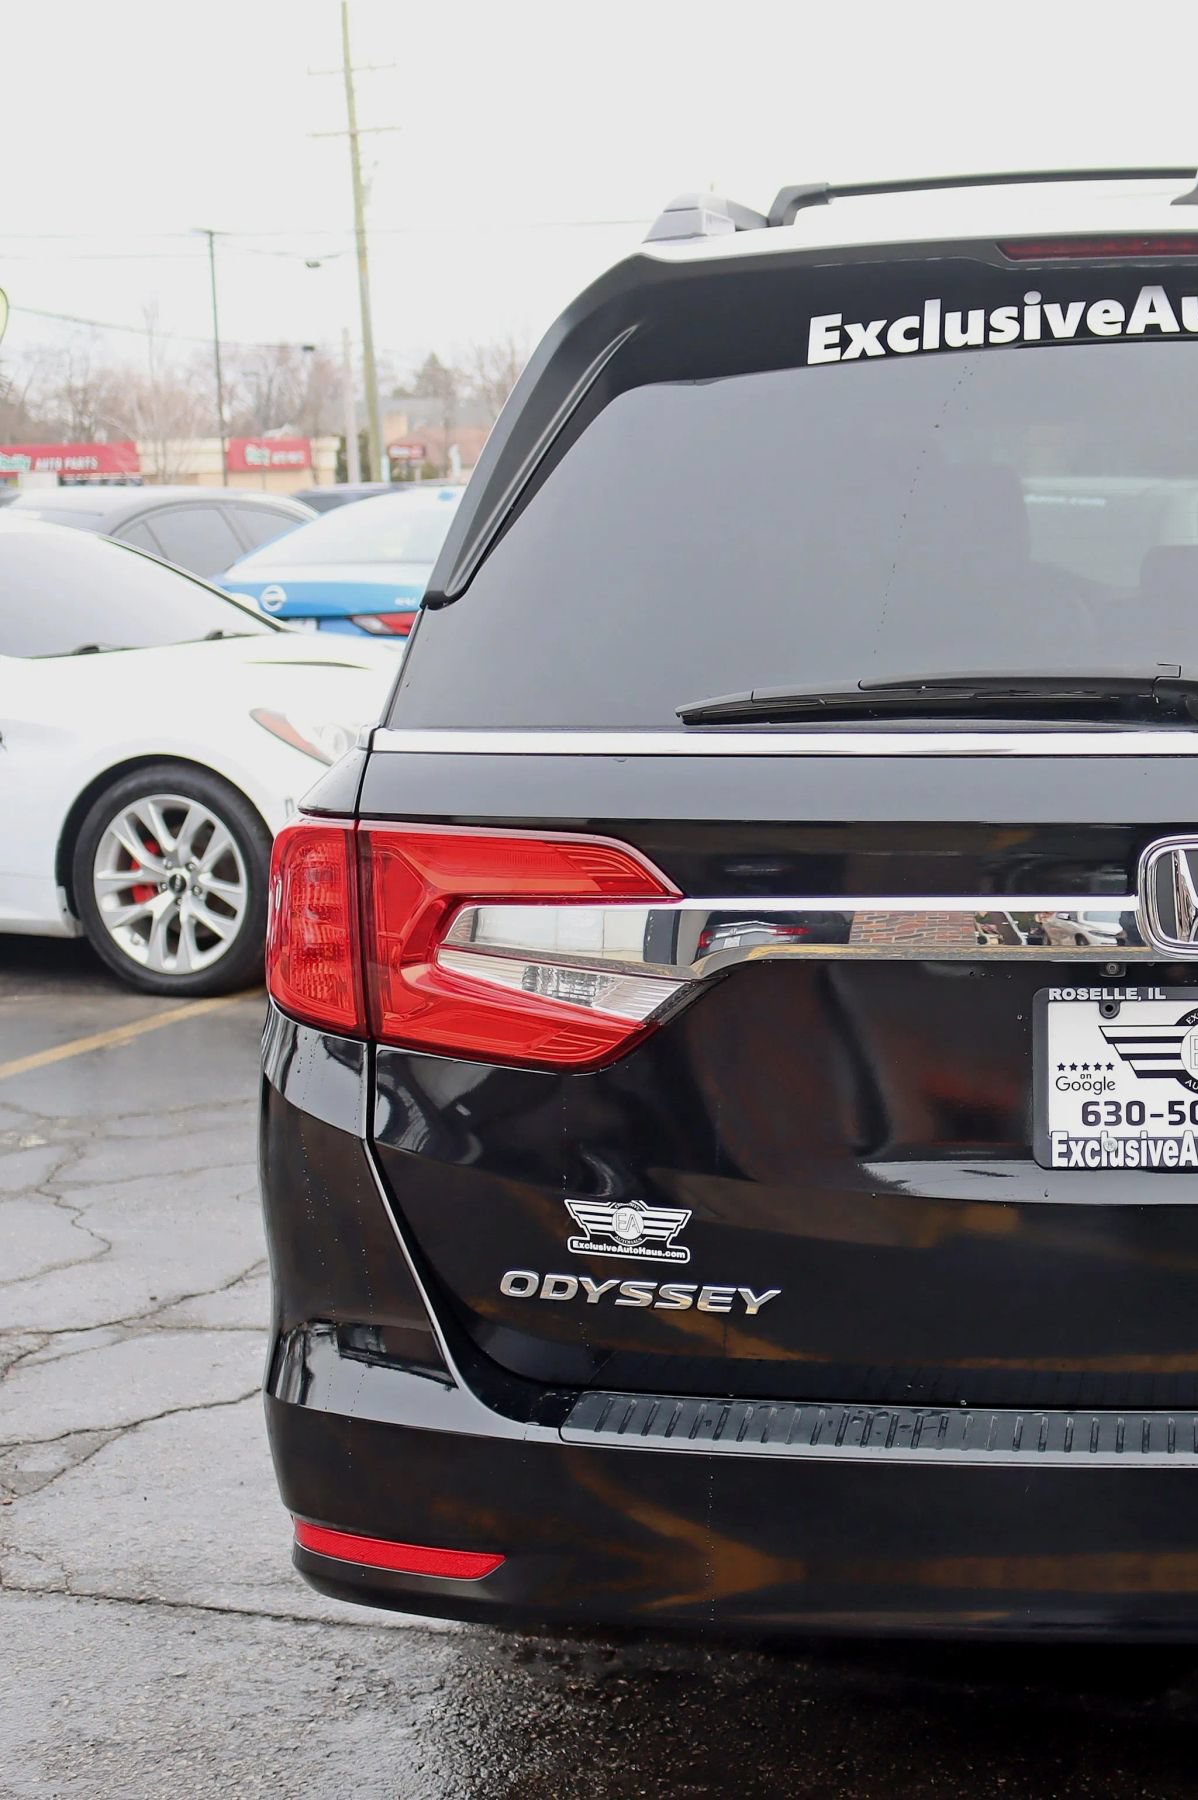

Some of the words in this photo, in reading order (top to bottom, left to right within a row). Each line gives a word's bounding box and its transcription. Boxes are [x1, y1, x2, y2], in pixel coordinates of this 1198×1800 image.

[1049, 987, 1142, 1001] ROSELLE,
[1148, 987, 1167, 1000] IL
[1055, 1076, 1116, 1095] Google
[572, 1240, 686, 1259] ExclusiveAutoHaus.com
[499, 1270, 782, 1315] ODYSSEY
